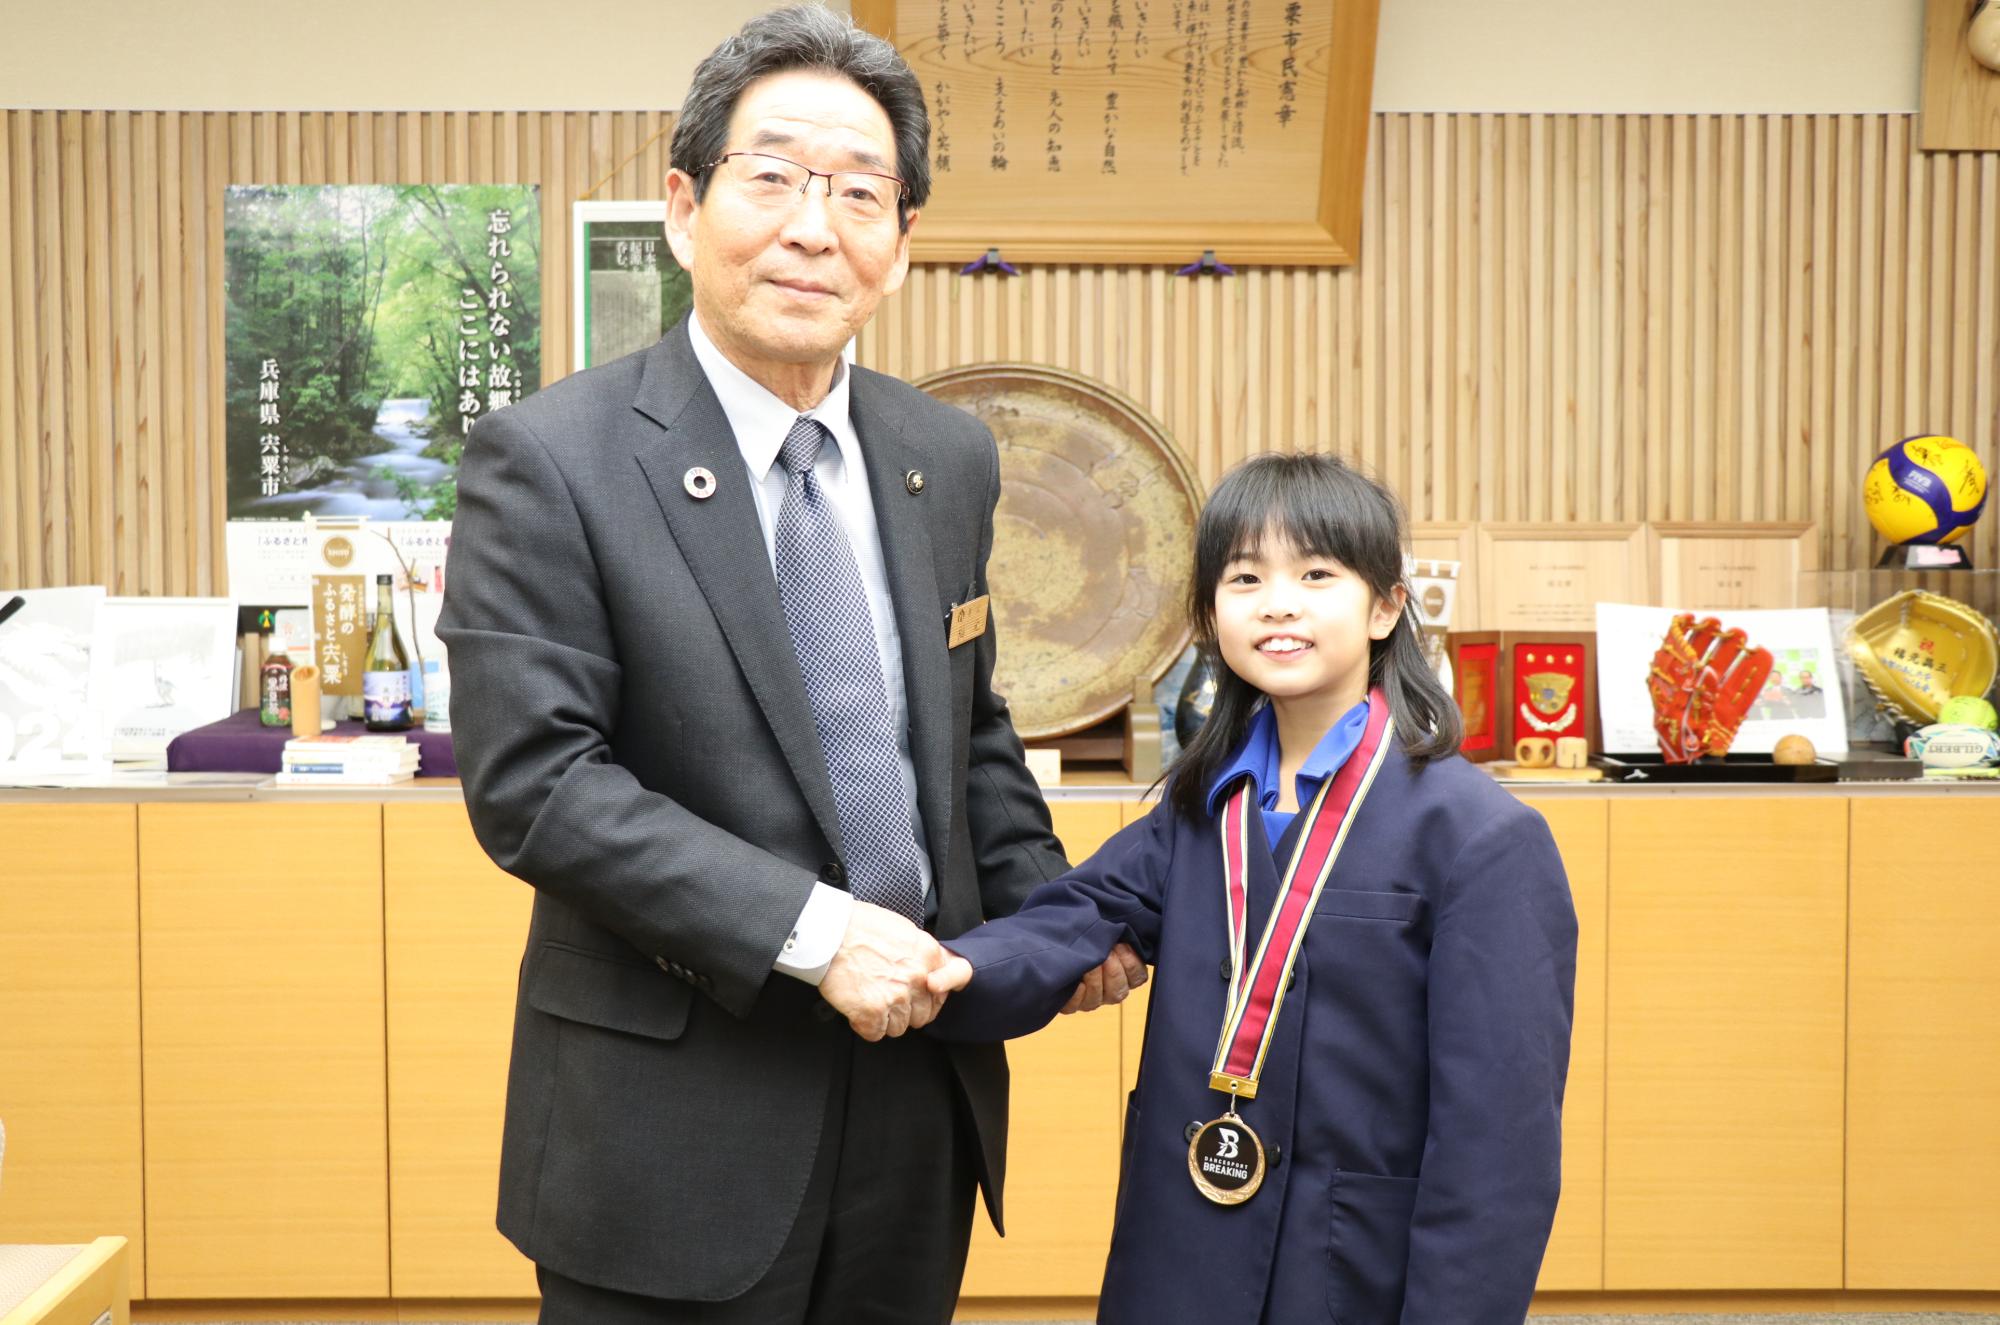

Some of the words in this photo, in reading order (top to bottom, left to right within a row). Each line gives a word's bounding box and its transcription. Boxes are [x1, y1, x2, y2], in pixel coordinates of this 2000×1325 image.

[1050, 0, 1064, 76] のあしあと
[1046, 89, 1064, 174] 先人の知恵
[487, 210, 512, 412] 忘れられない故郷
[259, 358, 280, 426] 兵庫県
[260, 432, 281, 497] 宍粟市
[339, 583, 357, 635] 発酵の
[1928, 741, 1983, 754] GILBERT
[1203, 1162, 1248, 1179] BREAKING
[1204, 1155, 1249, 1170] DANCESPORT
